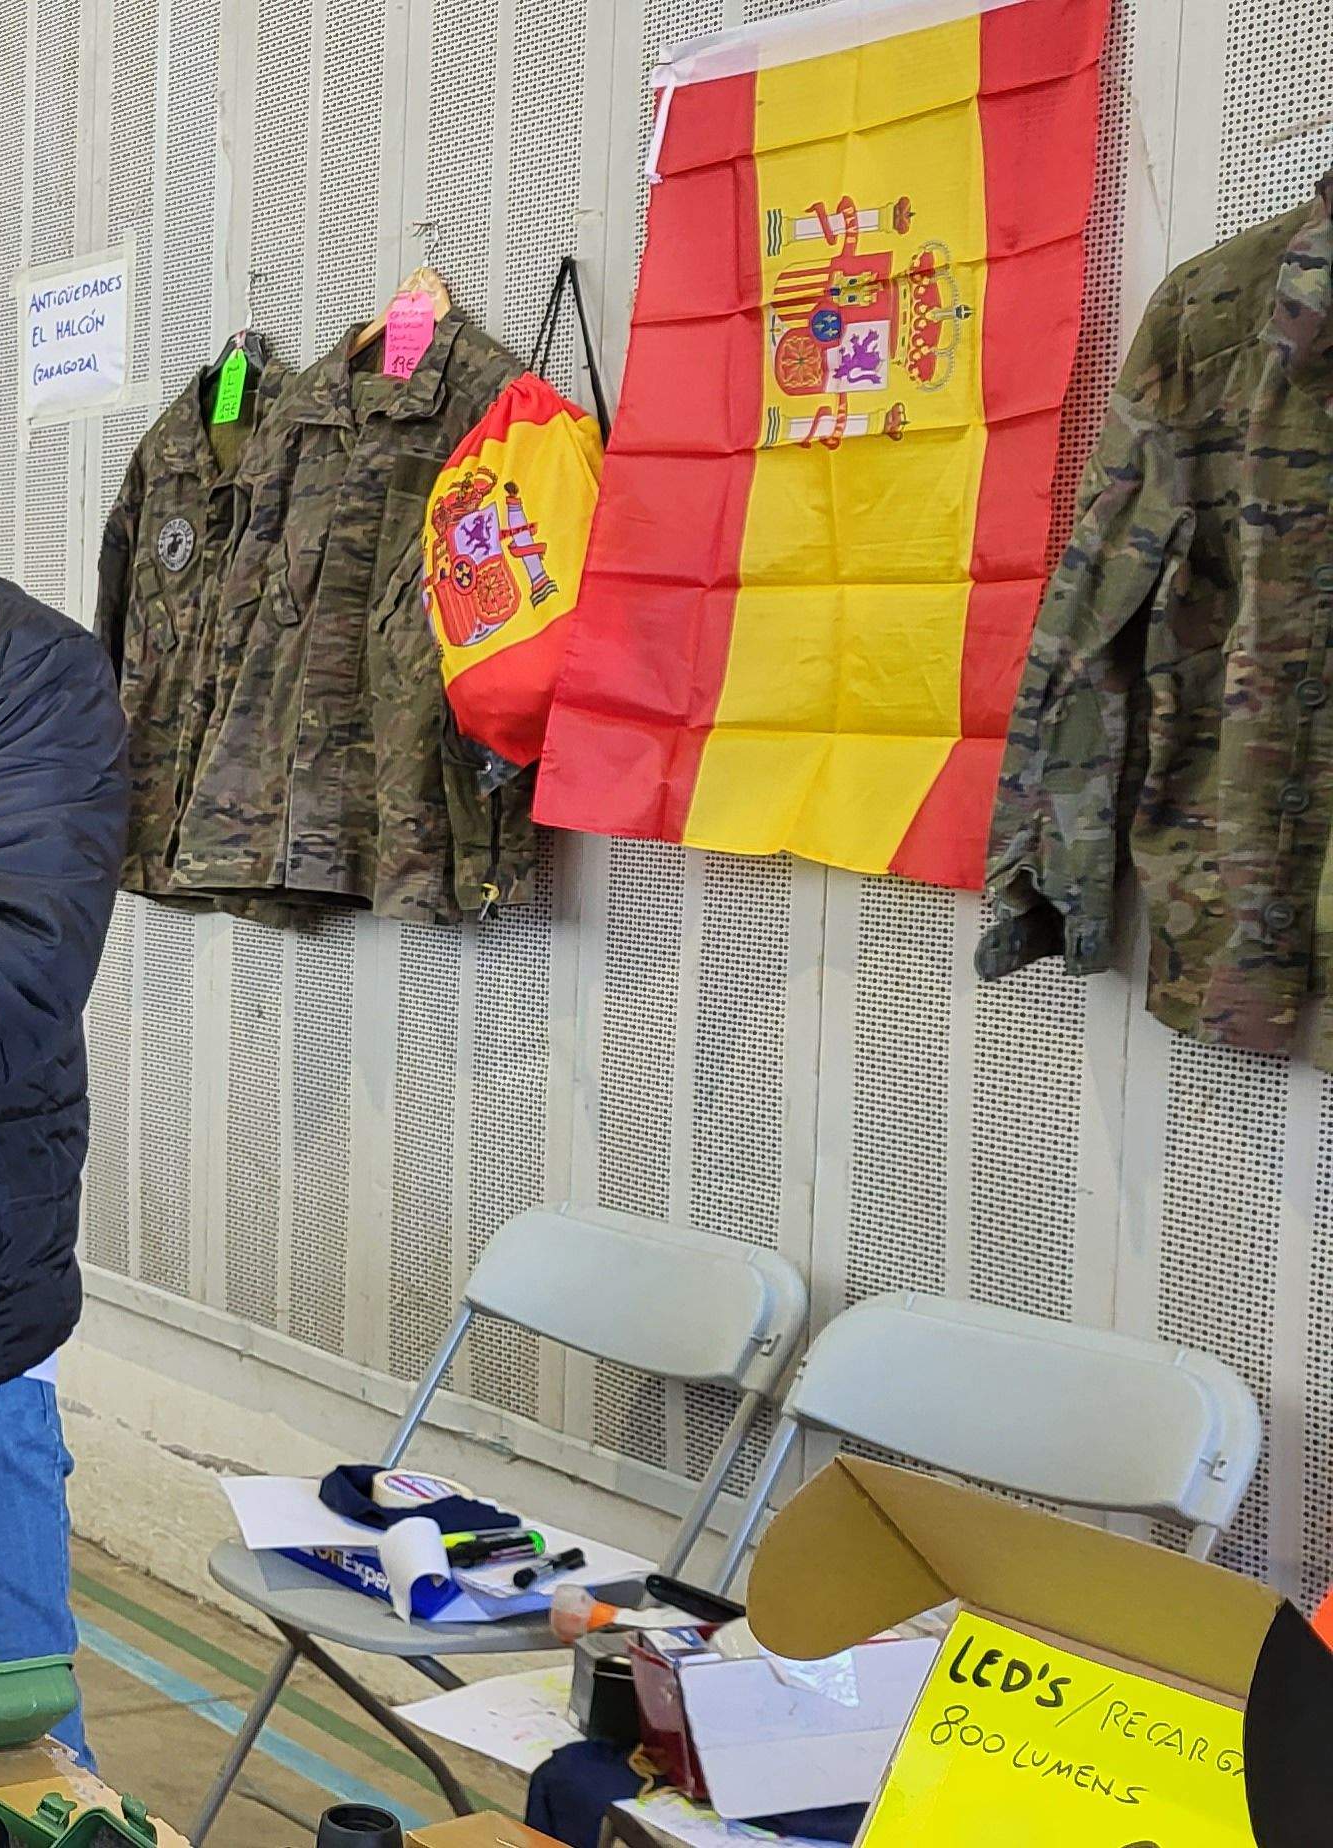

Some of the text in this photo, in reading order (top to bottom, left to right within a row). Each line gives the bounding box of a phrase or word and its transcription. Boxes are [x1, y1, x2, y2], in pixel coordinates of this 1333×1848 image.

[32, 308, 105, 348] EL HALCÓN
[33, 352, 99, 386] (ZARAGOZA)
[949, 1635, 1072, 1708] LED'S
[929, 1704, 1151, 1806] 800 LUMENS
